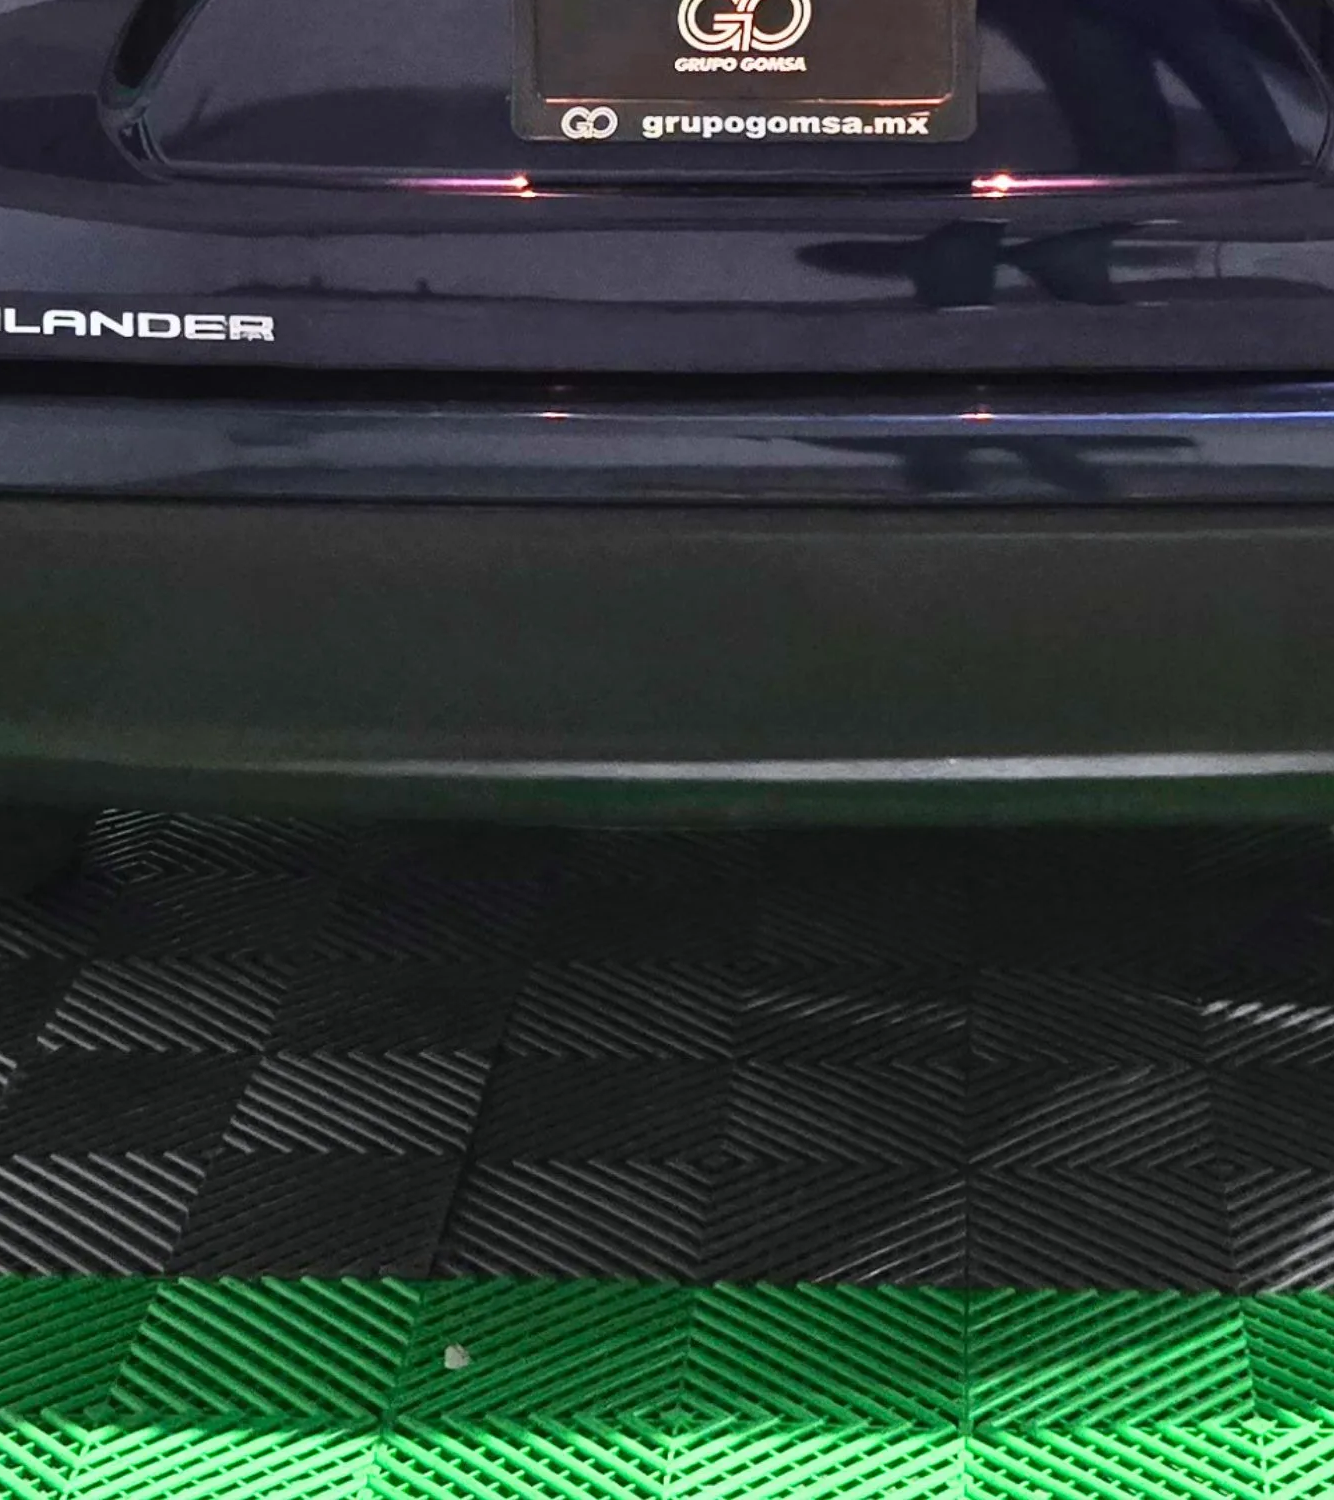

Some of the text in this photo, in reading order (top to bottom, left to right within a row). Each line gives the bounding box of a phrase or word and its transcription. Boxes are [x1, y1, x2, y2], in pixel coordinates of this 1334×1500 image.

[675, 56, 807, 72] GRUPO GOMSA
[642, 112, 929, 139] grupogomsa.mx
